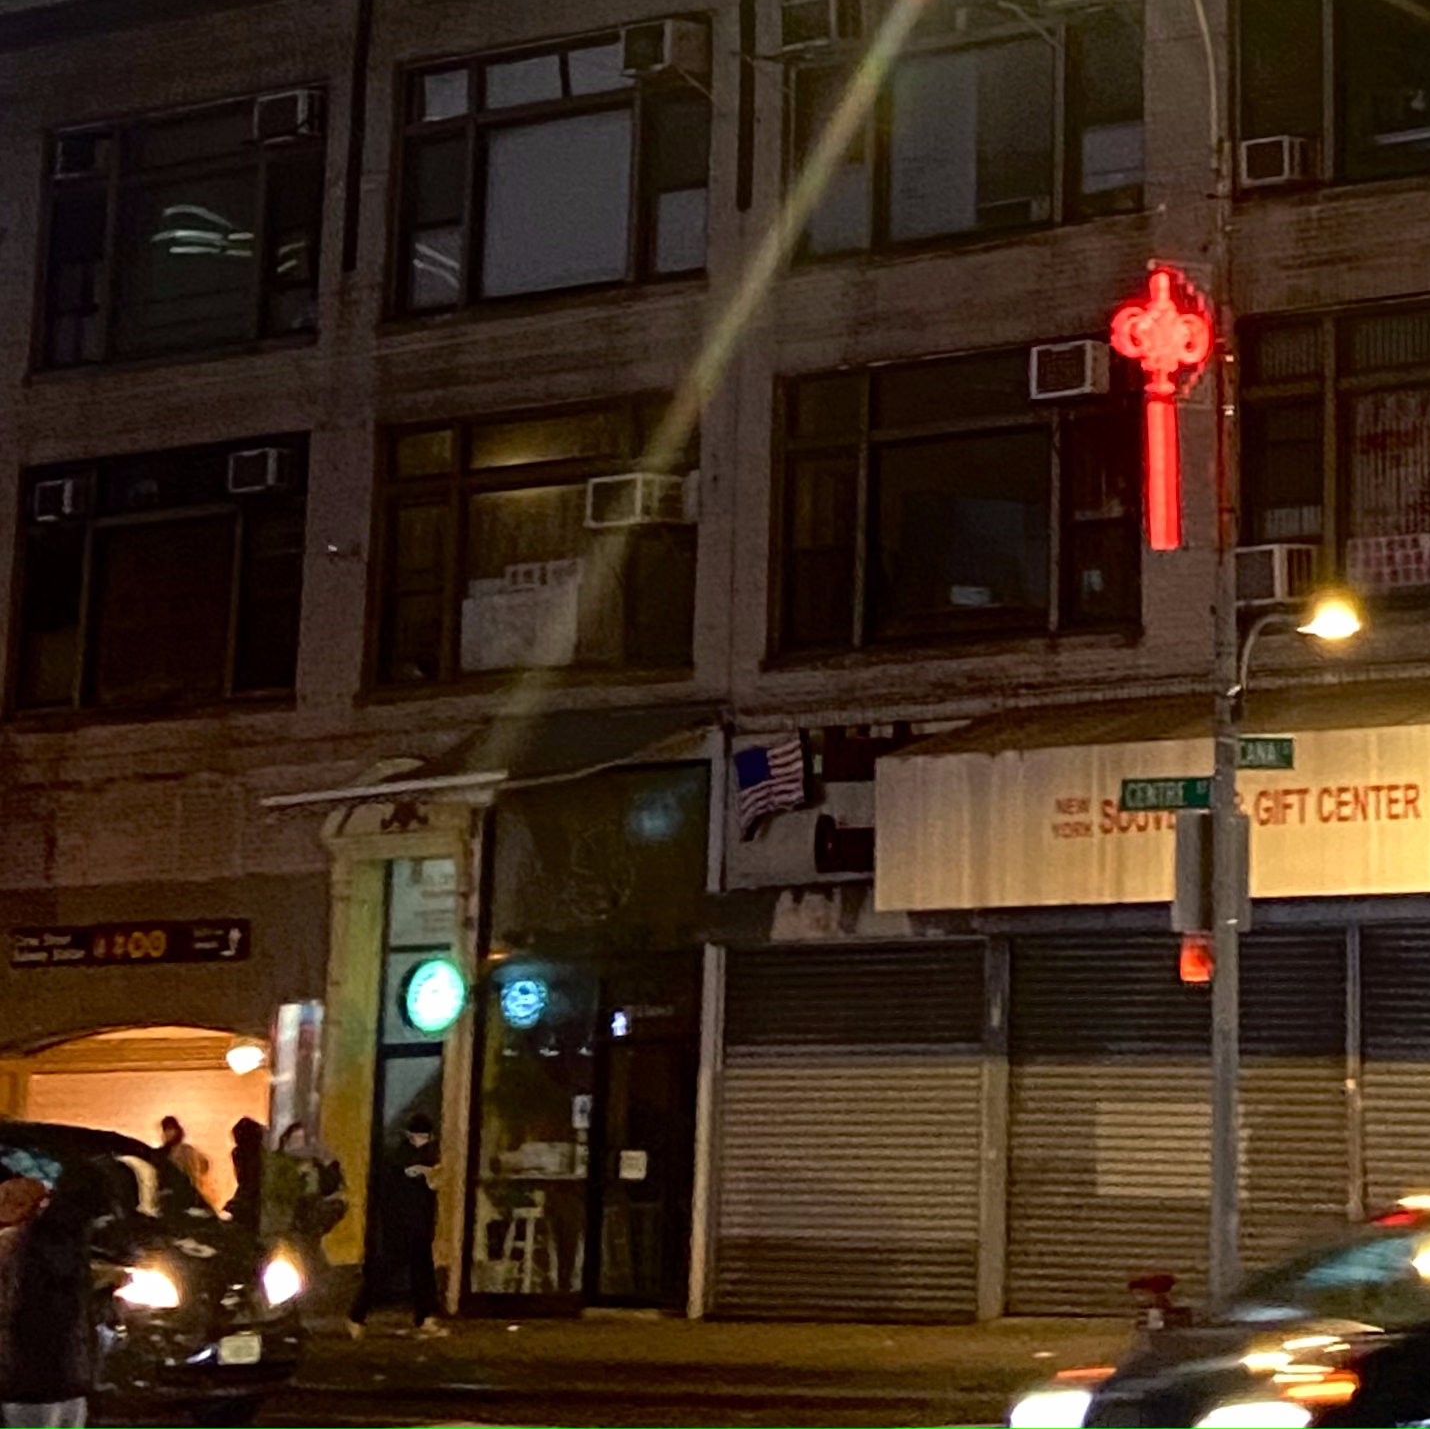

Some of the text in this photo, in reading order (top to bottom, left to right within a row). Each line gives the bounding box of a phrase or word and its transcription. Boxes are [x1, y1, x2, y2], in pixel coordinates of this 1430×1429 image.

[1055, 796, 1091, 815] NEW
[1123, 779, 1188, 808] CENTRE
[1253, 787, 1310, 827] GIFT
[1317, 782, 1423, 824] CENTER
[1052, 821, 1094, 839] YORK
